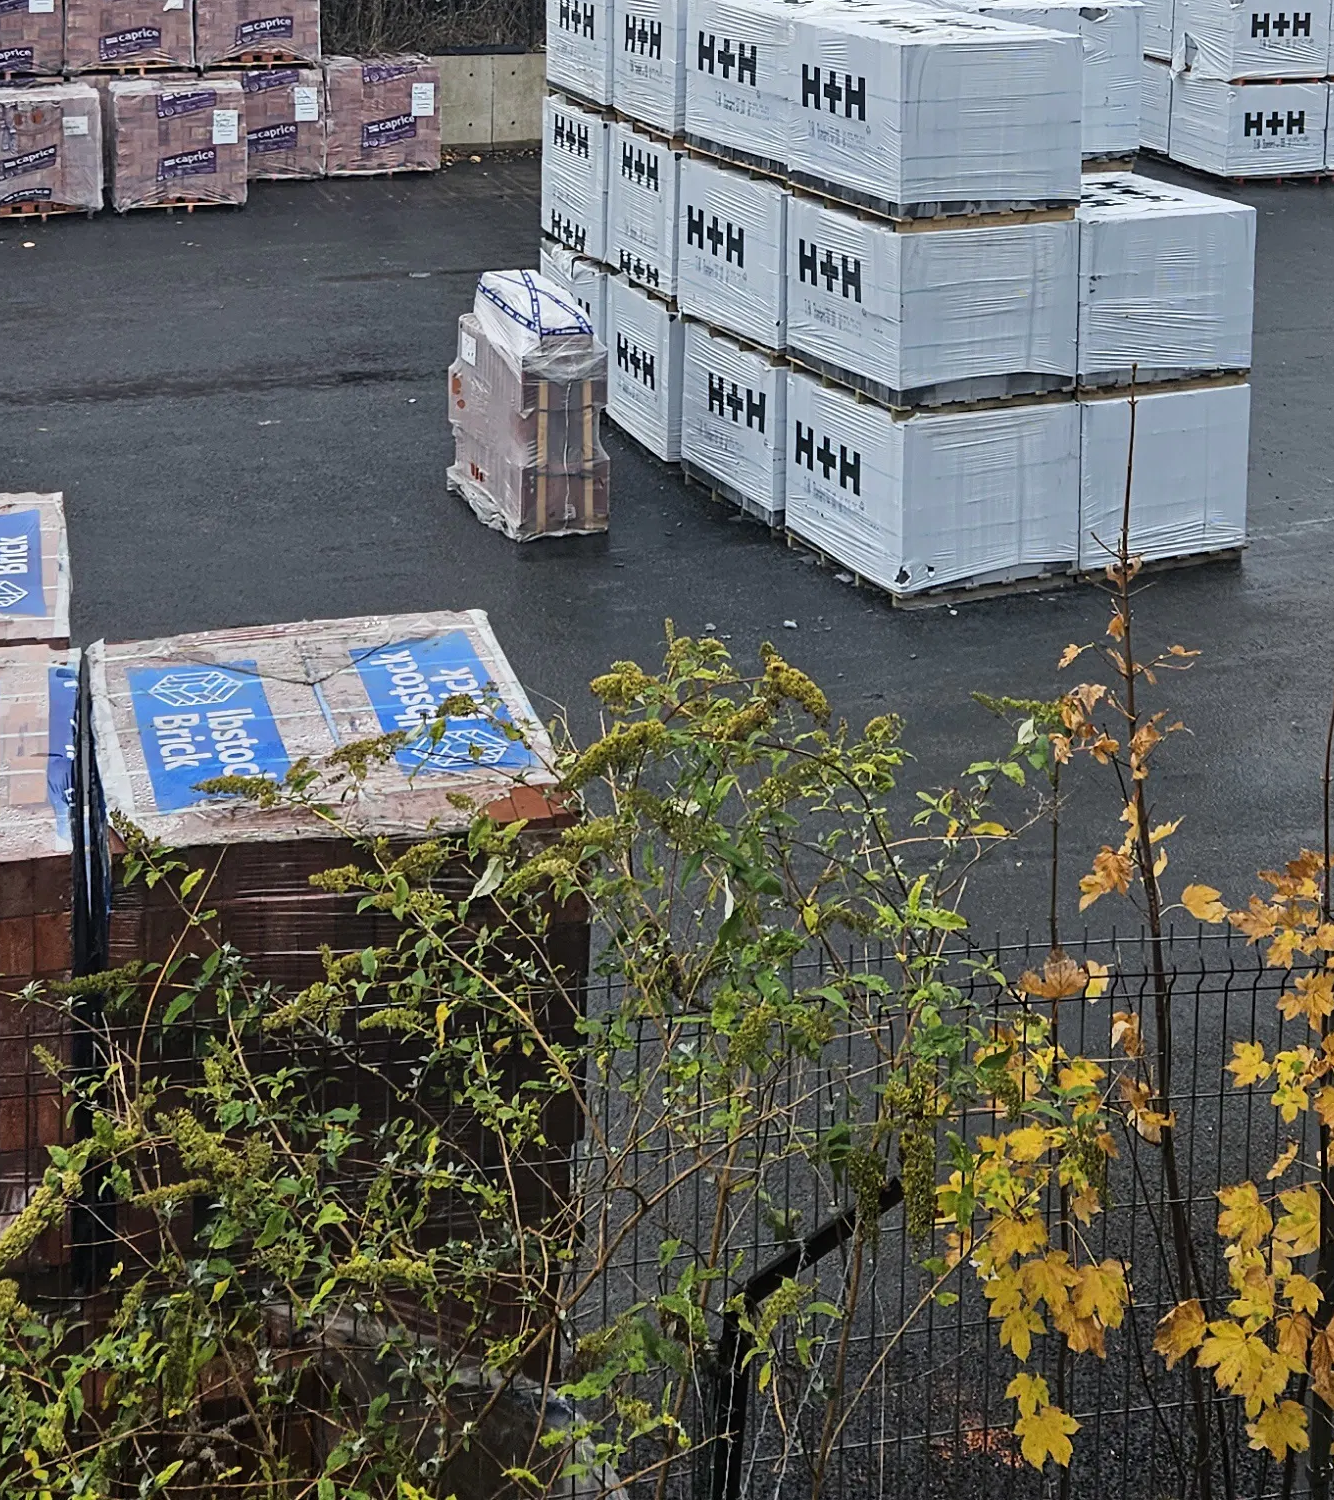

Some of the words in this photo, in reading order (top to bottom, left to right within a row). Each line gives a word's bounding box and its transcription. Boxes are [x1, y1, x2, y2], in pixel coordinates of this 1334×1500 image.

[118, 28, 160, 43] caprice
[254, 18, 292, 32] caprice
[624, 13, 662, 60] H+H
[1251, 12, 1311, 37] H+H
[698, 30, 757, 87] H+H
[802, 63, 866, 121] H+H
[258, 124, 296, 140] caprice
[379, 115, 415, 132] caprice
[554, 113, 589, 159] H+H
[1244, 111, 1305, 136] H+H
[16, 146, 55, 166] caprice
[175, 150, 215, 166] caprice
[622, 141, 659, 192] H+H
[551, 208, 586, 253] H+H
[687, 204, 745, 269] H+H
[620, 248, 659, 287] H+H
[799, 238, 862, 303] H+H
[617, 331, 655, 391] H+H
[708, 372, 766, 434] H+H
[795, 420, 860, 497] H+H
[369, 649, 444, 728] Ibstock
[153, 713, 212, 772] Brick
[205, 707, 277, 779] Ibstoc
